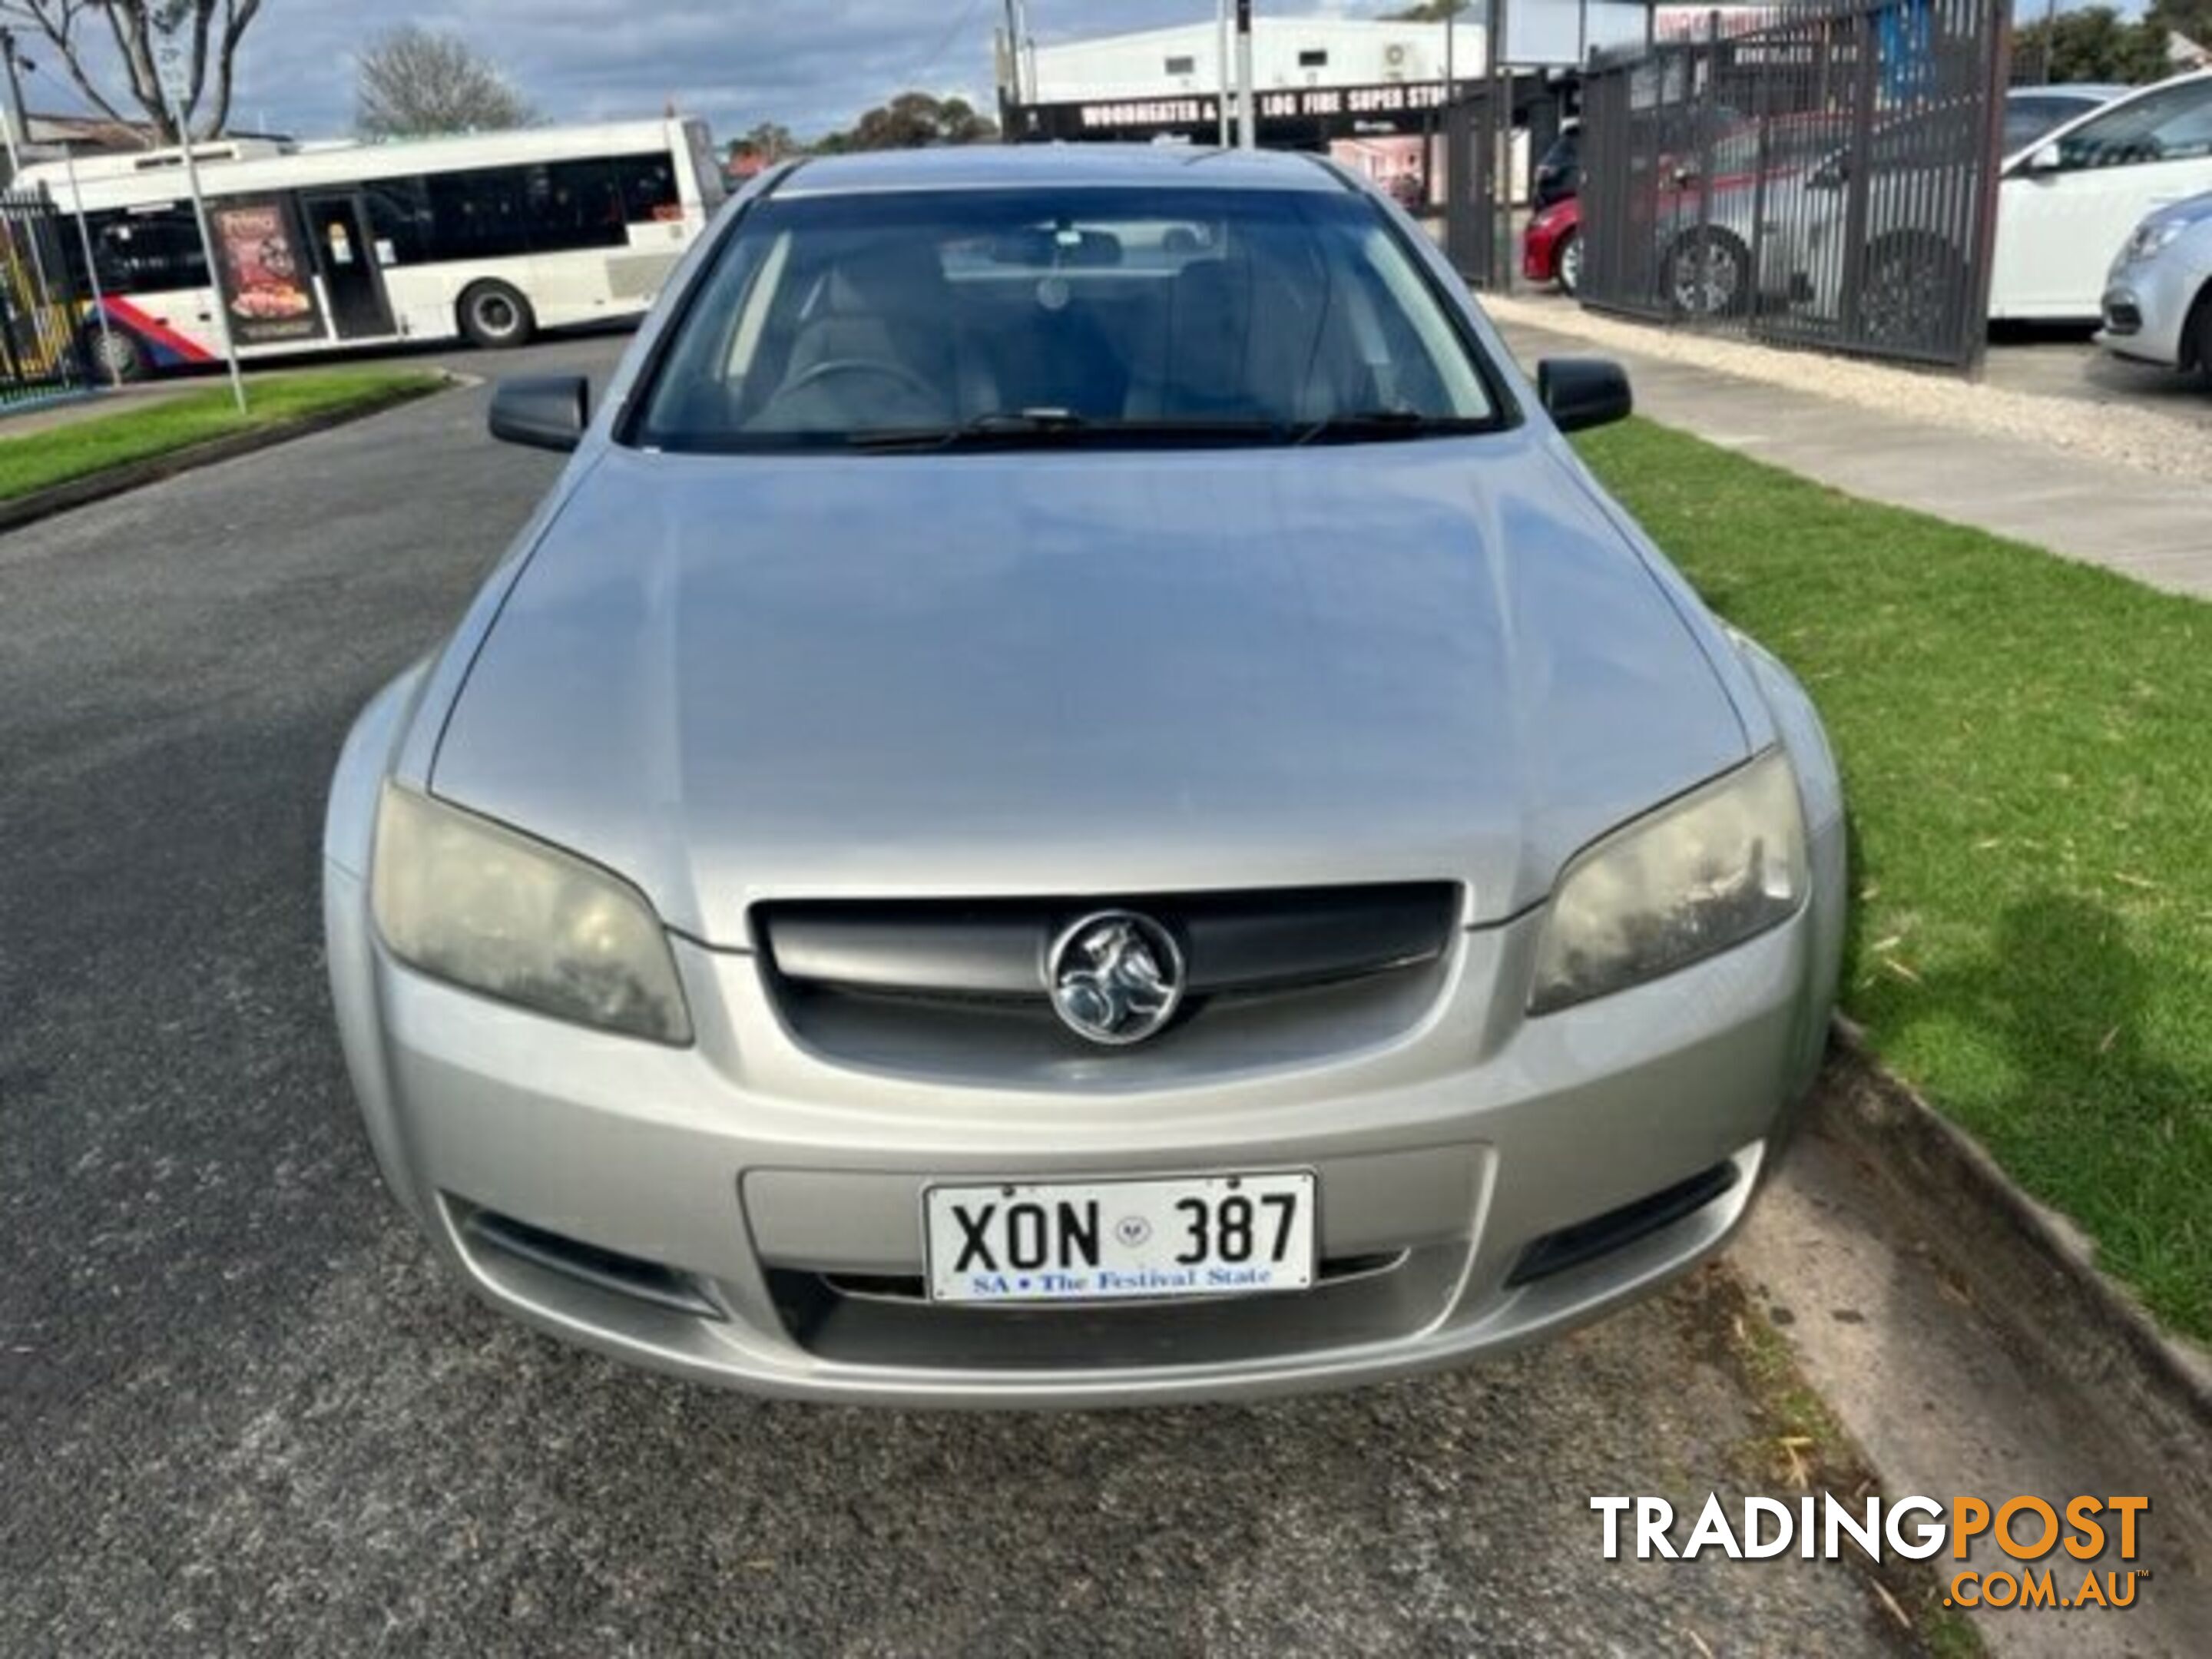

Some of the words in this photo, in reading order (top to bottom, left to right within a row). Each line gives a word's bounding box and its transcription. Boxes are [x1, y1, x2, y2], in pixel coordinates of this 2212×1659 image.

[1261, 93, 1296, 116] LOG
[1303, 91, 1341, 114] FIRE
[1348, 87, 1403, 111] SUPER
[952, 1200, 1100, 1272] XON
[1175, 1193, 1296, 1265] 387
[973, 1276, 1009, 1293] SA
[1041, 1273, 1088, 1292] The
[1098, 1270, 1195, 1290] Festival
[1206, 1267, 1272, 1284] State
